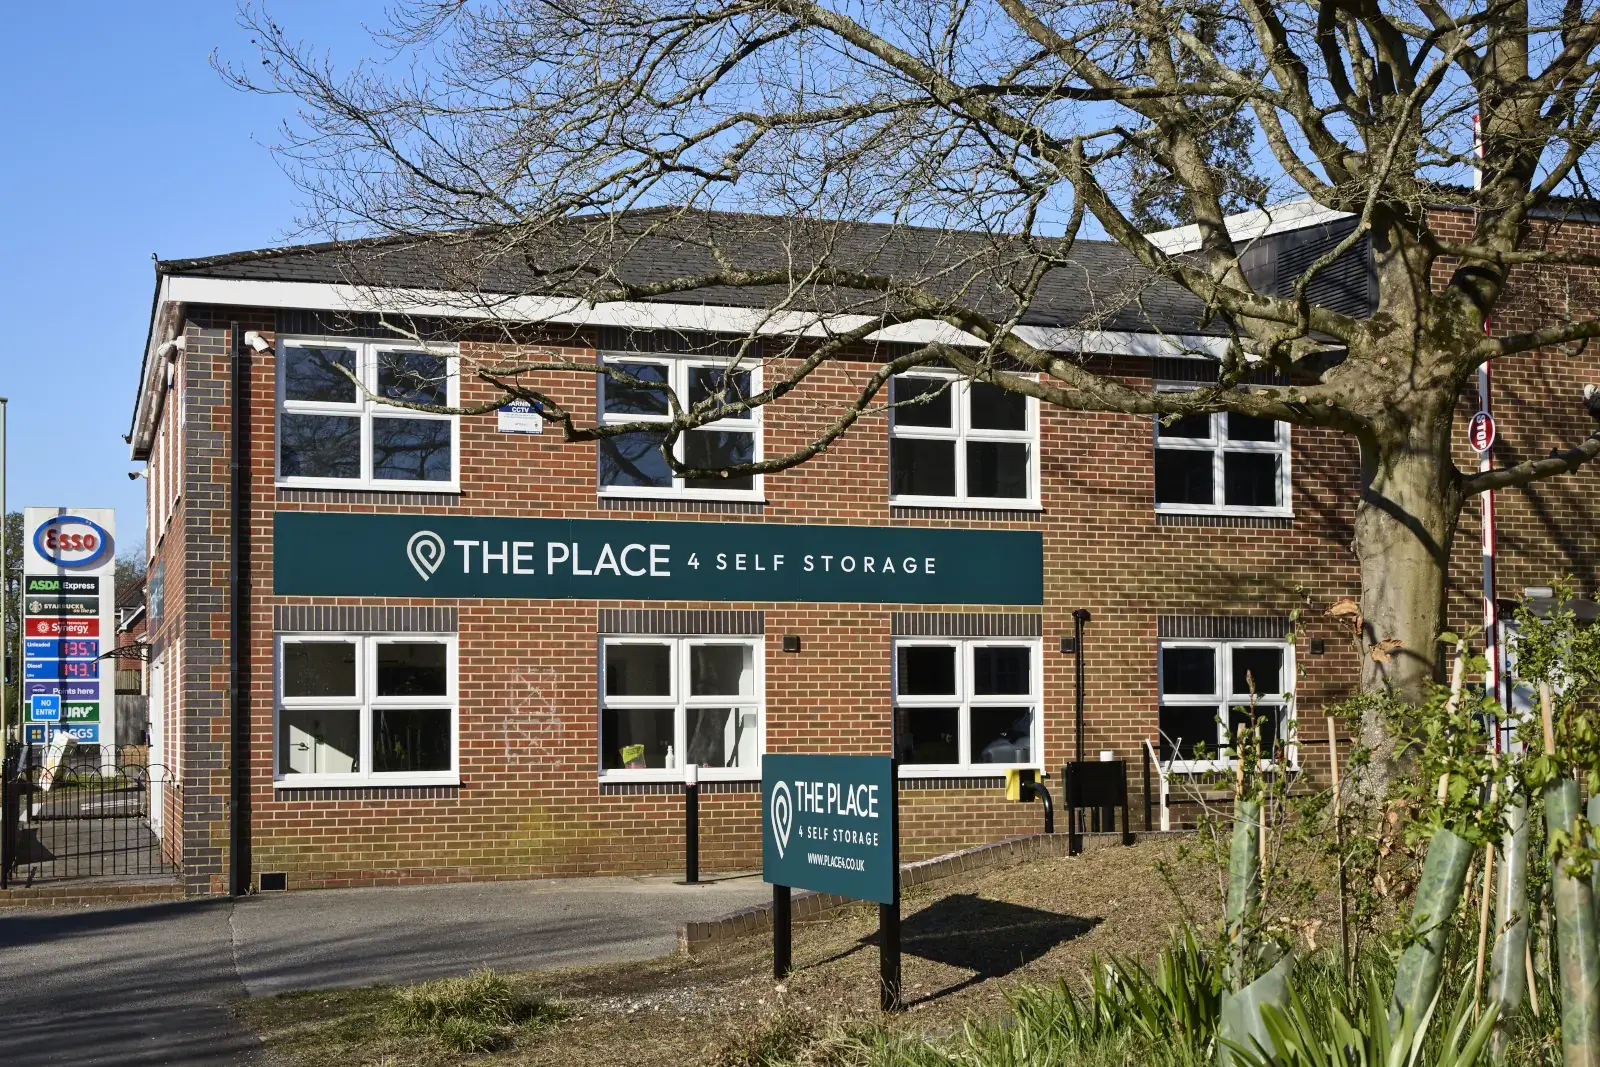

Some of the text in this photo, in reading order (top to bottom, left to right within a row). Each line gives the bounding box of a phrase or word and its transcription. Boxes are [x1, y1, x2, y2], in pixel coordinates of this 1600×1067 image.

[1476, 414, 1487, 450] STOP
[46, 529, 95, 550] Esso
[453, 539, 936, 577] THE PLACE 4 SELF STORAGE
[29, 580, 95, 590] ASDA Express
[51, 622, 89, 634] Synergy
[64, 642, 96, 656] 135.7
[35, 708, 57, 716] ENTRY
[60, 706, 93, 718] WAY
[44, 728, 94, 739] GGGS
[795, 781, 879, 818] THE PLACE
[798, 826, 879, 846] 4 SELF STORAGE
[807, 852, 865, 871] WWW.PLACE4.CO.UK
